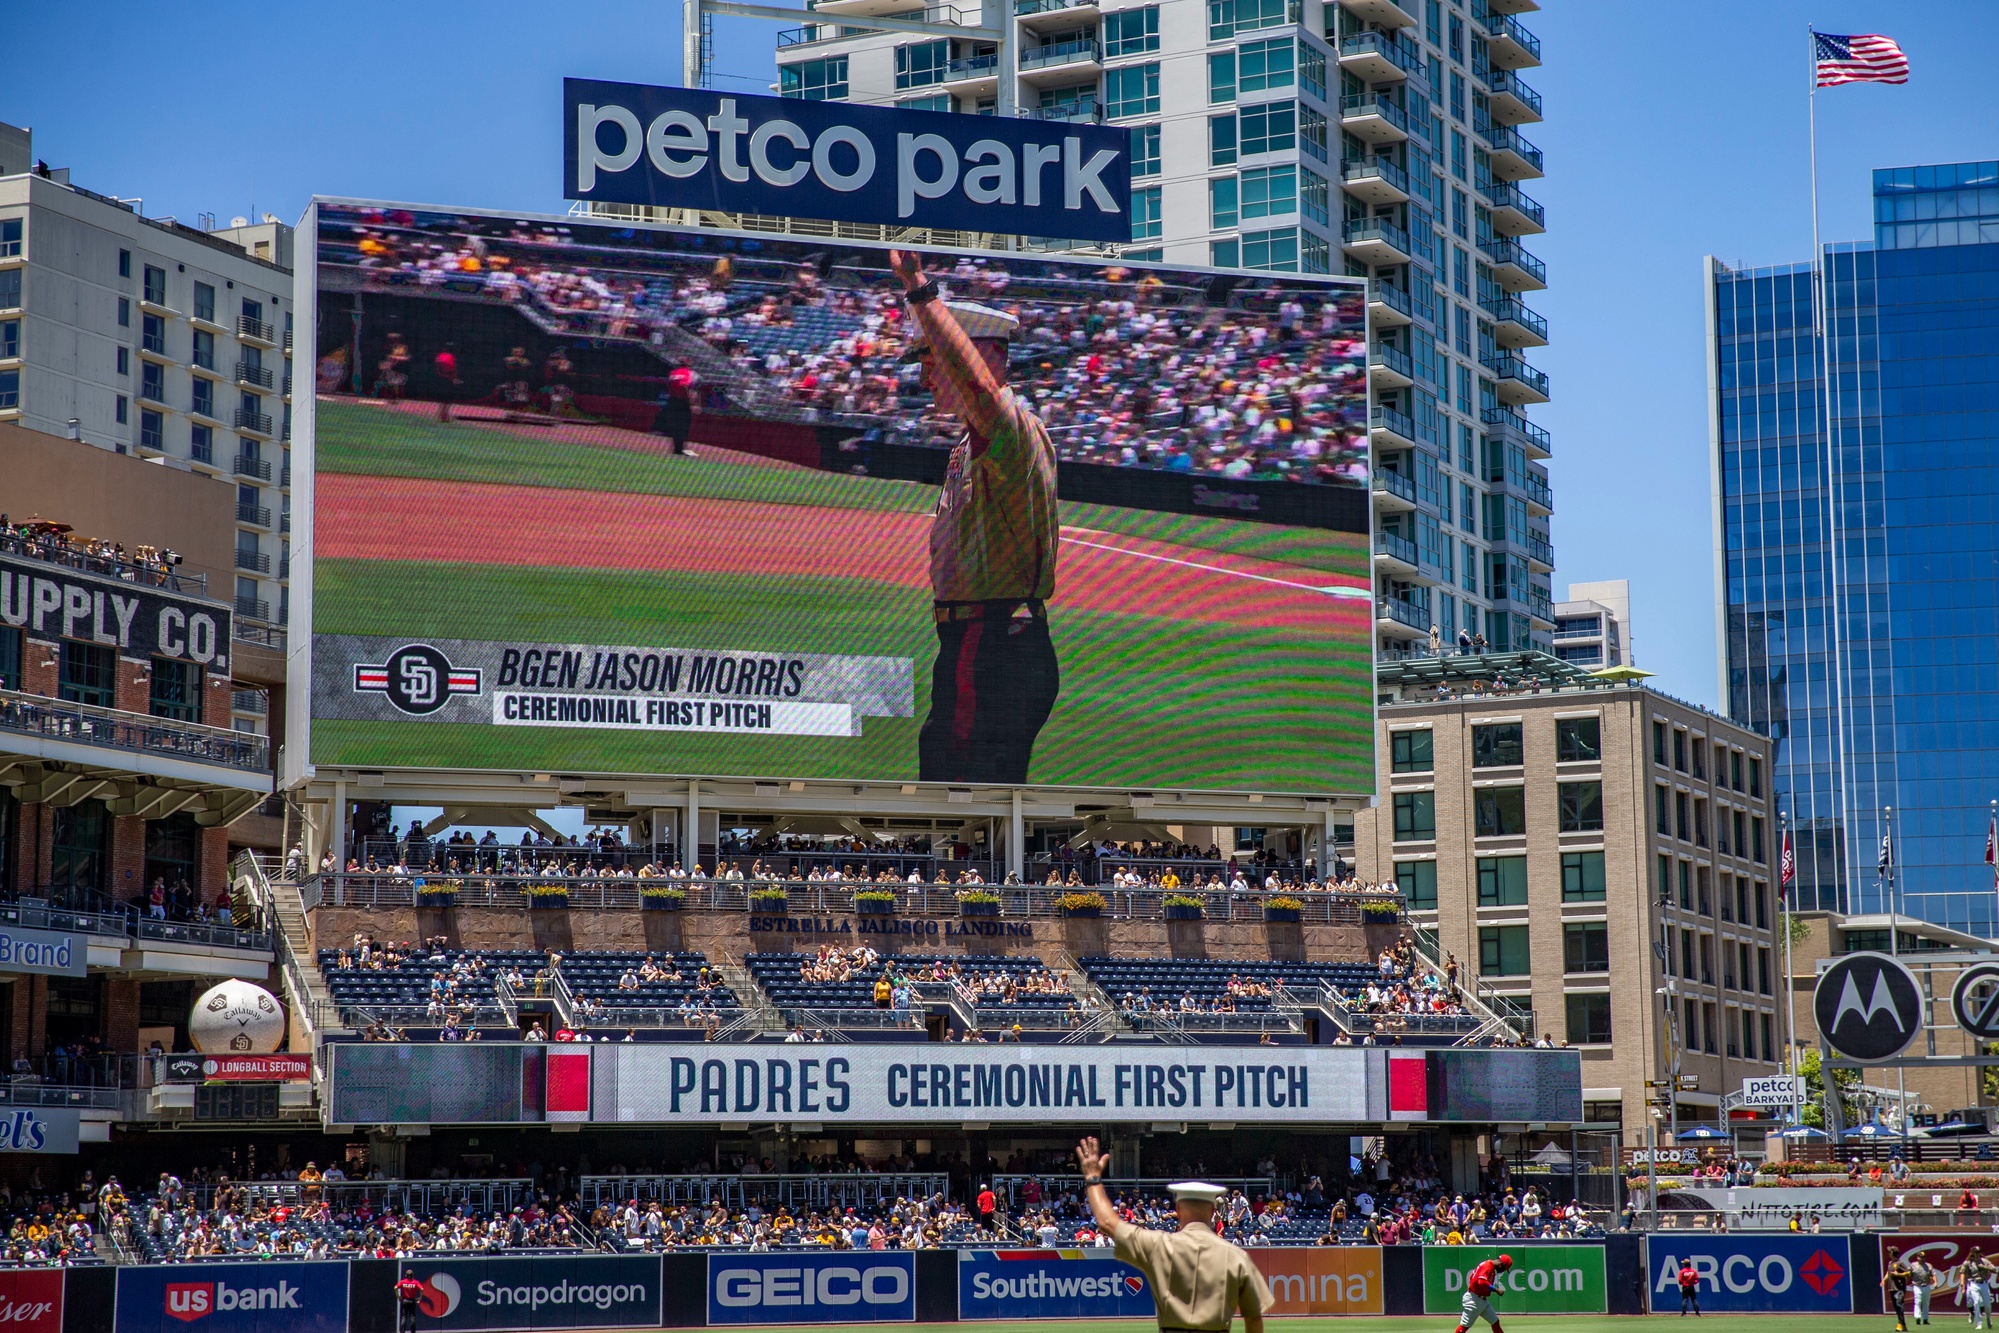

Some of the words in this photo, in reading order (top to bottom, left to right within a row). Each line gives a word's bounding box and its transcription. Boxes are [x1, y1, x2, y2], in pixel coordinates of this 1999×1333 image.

[578, 98, 876, 192] petco
[897, 132, 1121, 218] park
[158, 606, 226, 667] CO.
[497, 648, 582, 688] BGEN
[585, 652, 684, 692] JASON
[687, 656, 804, 697] MORRIS
[504, 695, 641, 724] CEREMONIAL
[649, 700, 706, 726] FIRST
[710, 702, 771, 728] PITCH
[749, 917, 851, 934] ESTRELLA
[858, 918, 938, 936] JALISCO
[945, 920, 1032, 937] LANDING
[0, 934, 72, 967] Brand
[224, 1007, 262, 1020] Callaway
[171, 1060, 198, 1070] Callaway
[222, 1062, 267, 1072] LONGBALL
[269, 1062, 307, 1072] SECTION
[669, 1057, 850, 1113] PADRES
[887, 1063, 1106, 1107] CEREMONIAL
[1115, 1064, 1206, 1107] FIRST
[1214, 1065, 1308, 1108] PITCH
[1741, 1200, 1878, 1221] NITTOTIRE.COM
[716, 1267, 909, 1306] GEICO
[973, 1270, 1123, 1299] Southwest
[1445, 1268, 1584, 1292] Dxcom
[1655, 1254, 1793, 1294] ARCO
[170, 1289, 208, 1312] us
[477, 1279, 646, 1310] Snapdragon
